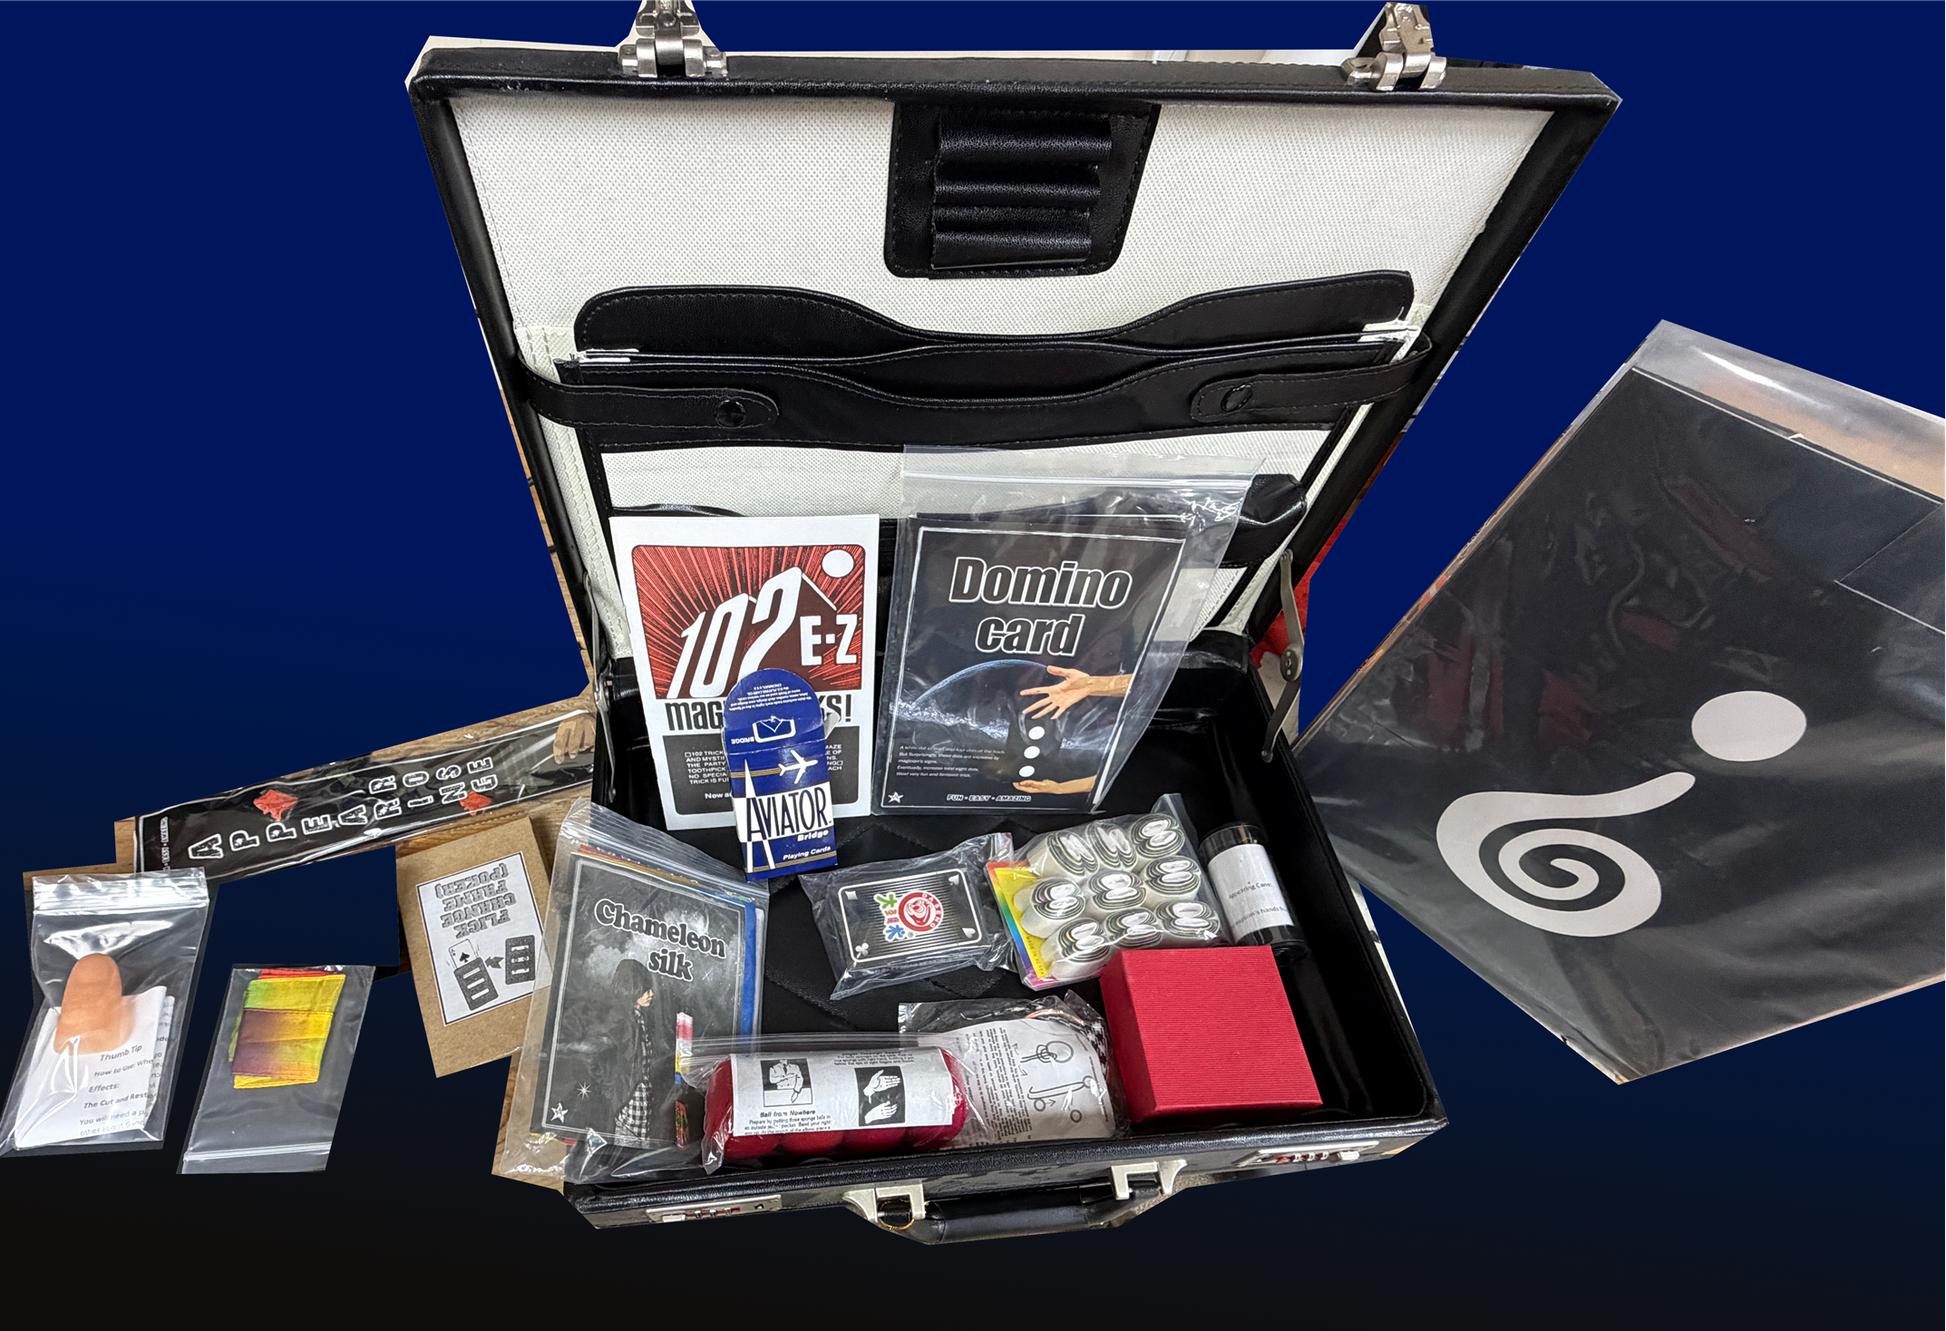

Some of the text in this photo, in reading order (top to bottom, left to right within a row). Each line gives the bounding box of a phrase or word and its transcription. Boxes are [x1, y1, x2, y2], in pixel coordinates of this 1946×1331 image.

[950, 557, 1132, 610] Domino
[666, 567, 857, 699] 102 E-Z
[975, 614, 1085, 656] card
[731, 736, 754, 745] BRIDGE
[370, 757, 493, 794] ROSE
[189, 774, 498, 859] APPEARING
[747, 786, 832, 842] AVIATOR
[797, 829, 829, 842] Bridge
[782, 845, 831, 861] Playing Cards
[440, 892, 515, 928] CHANGE
[442, 881, 508, 912] FRAME
[456, 910, 510, 939] FLICK
[594, 898, 726, 959] Chameleon
[647, 948, 694, 981] silk
[100, 1045, 142, 1061] Thumb Tip
[89, 1084, 120, 1093] Effects:
[115, 1095, 129, 1103] and
[111, 1110, 130, 1119] need
[80, 1128, 99, 1136] other
